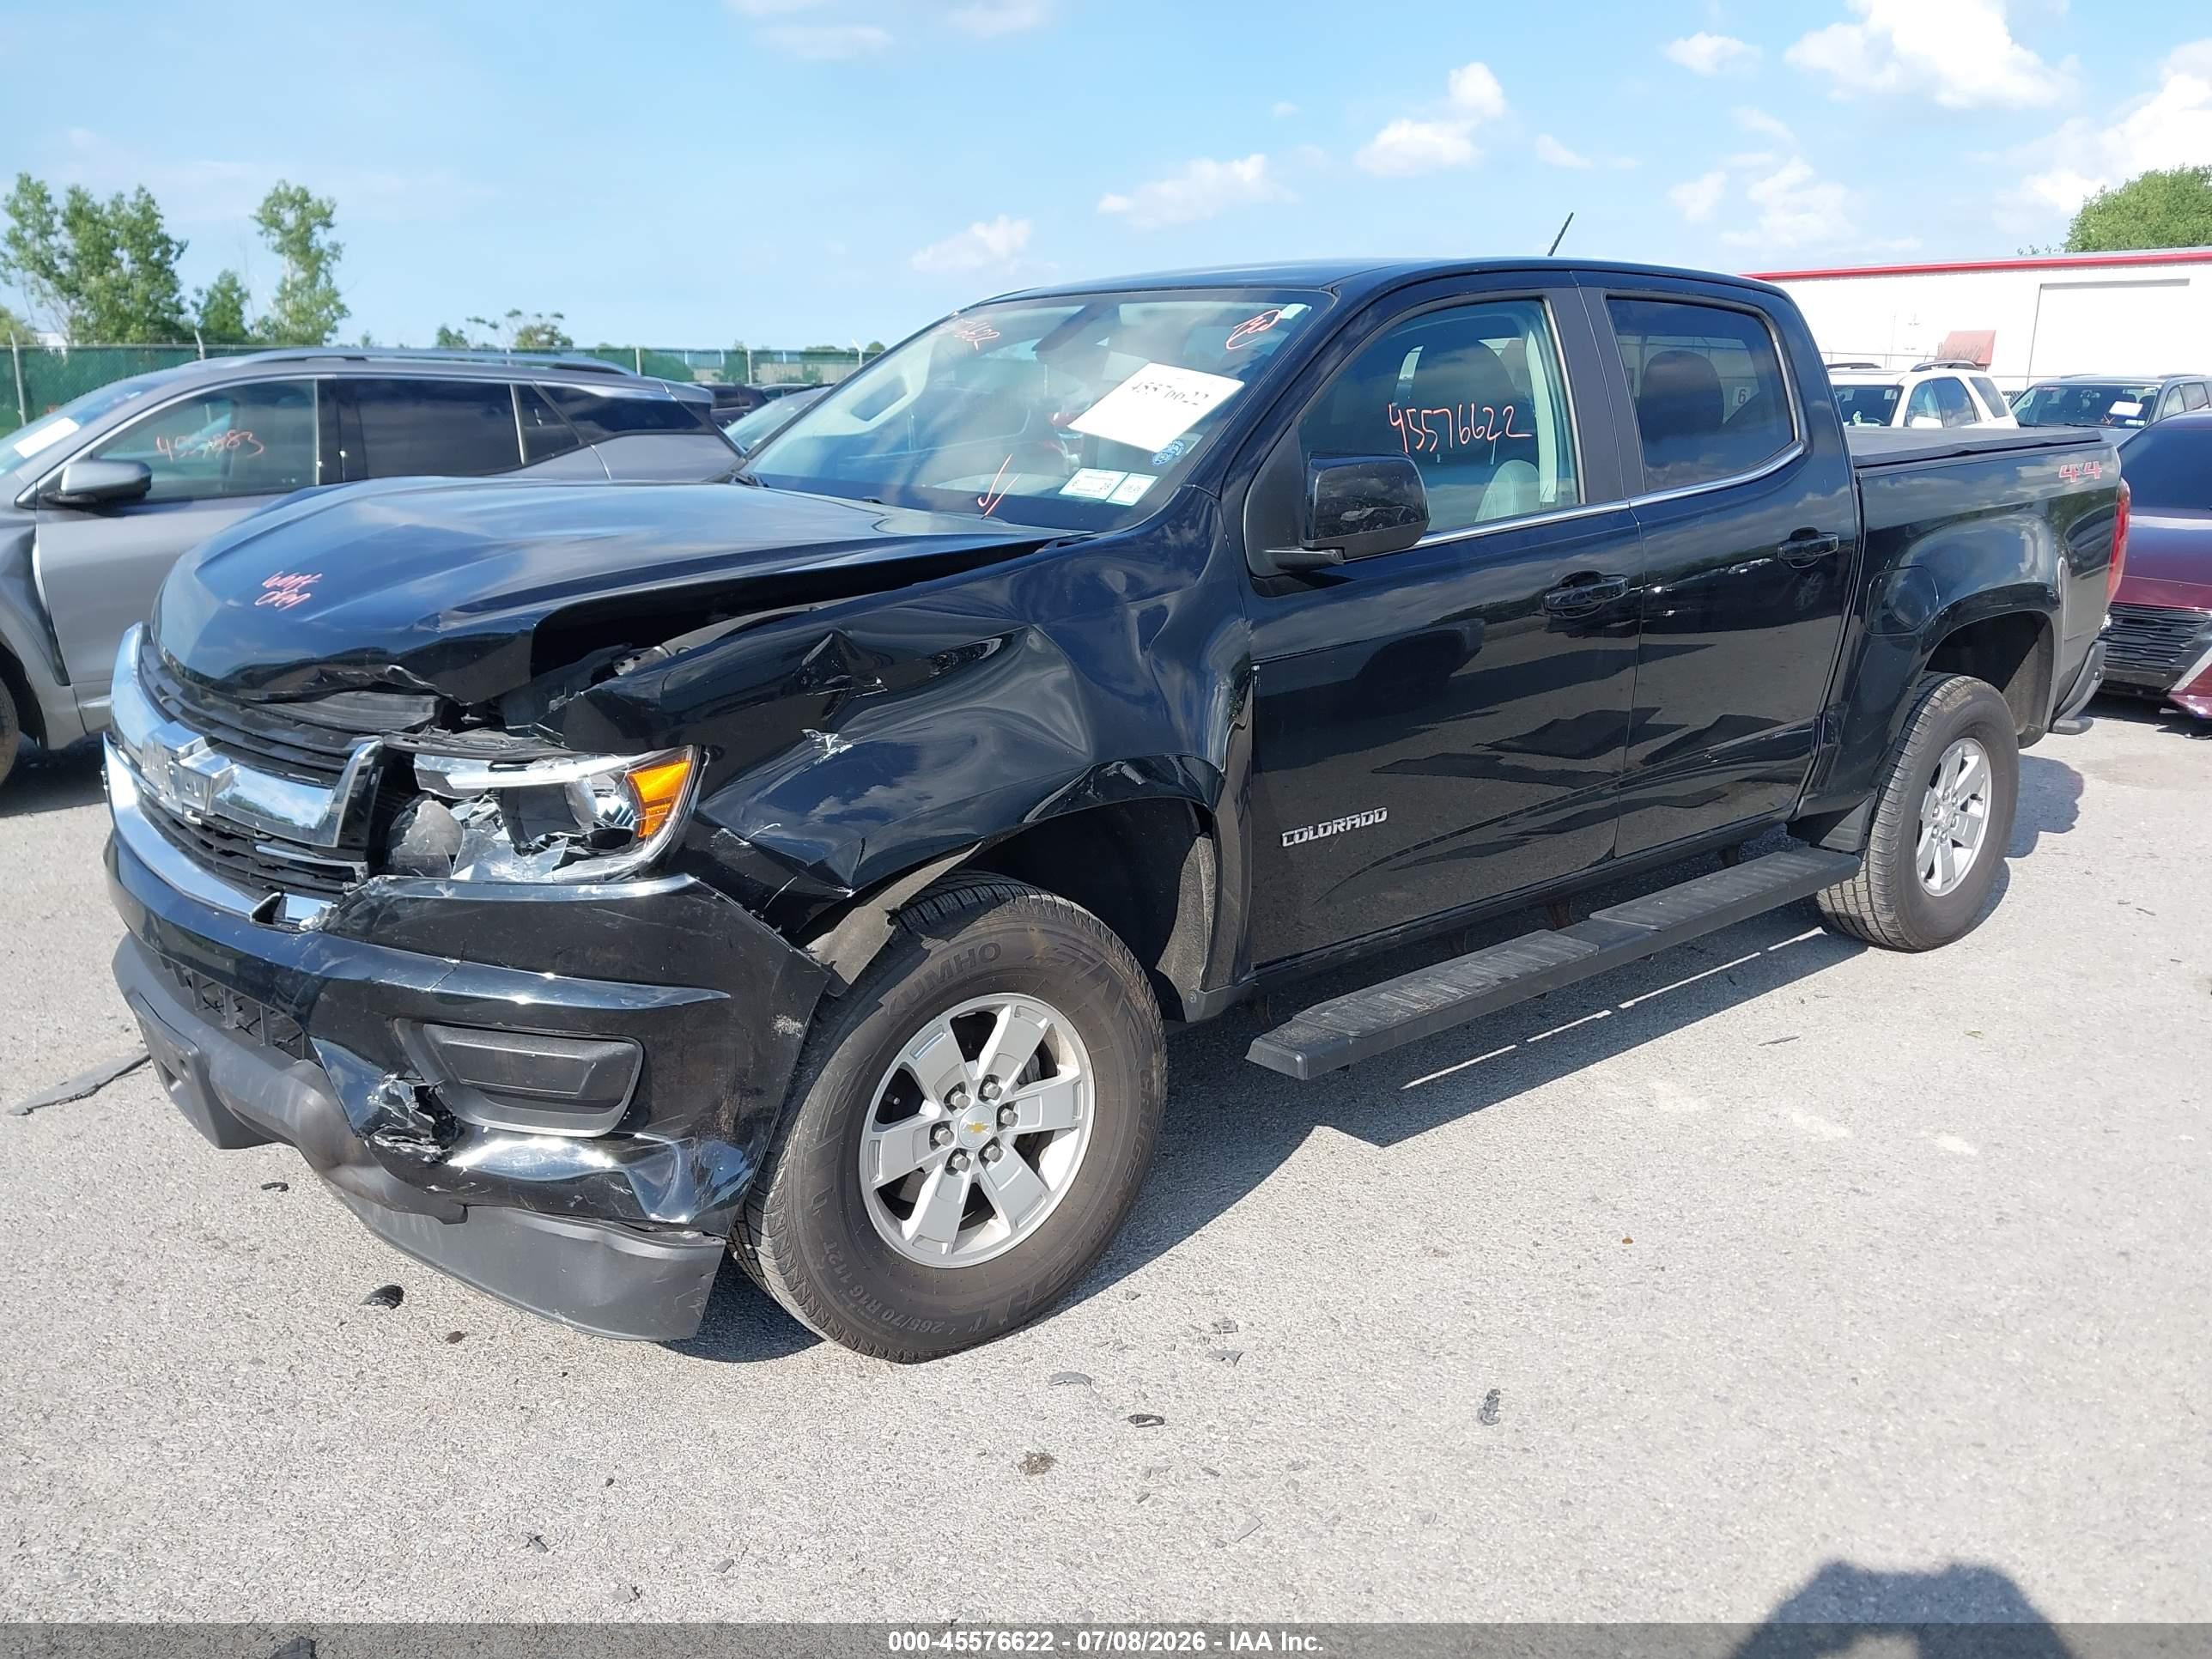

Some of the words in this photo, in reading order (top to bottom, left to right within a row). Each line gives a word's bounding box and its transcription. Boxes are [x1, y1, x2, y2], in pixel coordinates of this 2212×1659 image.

[1737, 388, 1747, 404] 6
[1388, 402, 1532, 453] 45576622
[1281, 806, 1388, 848] COLORADO
[882, 942, 1001, 1018] KUMHO
[847, 1280, 884, 1315] R16
